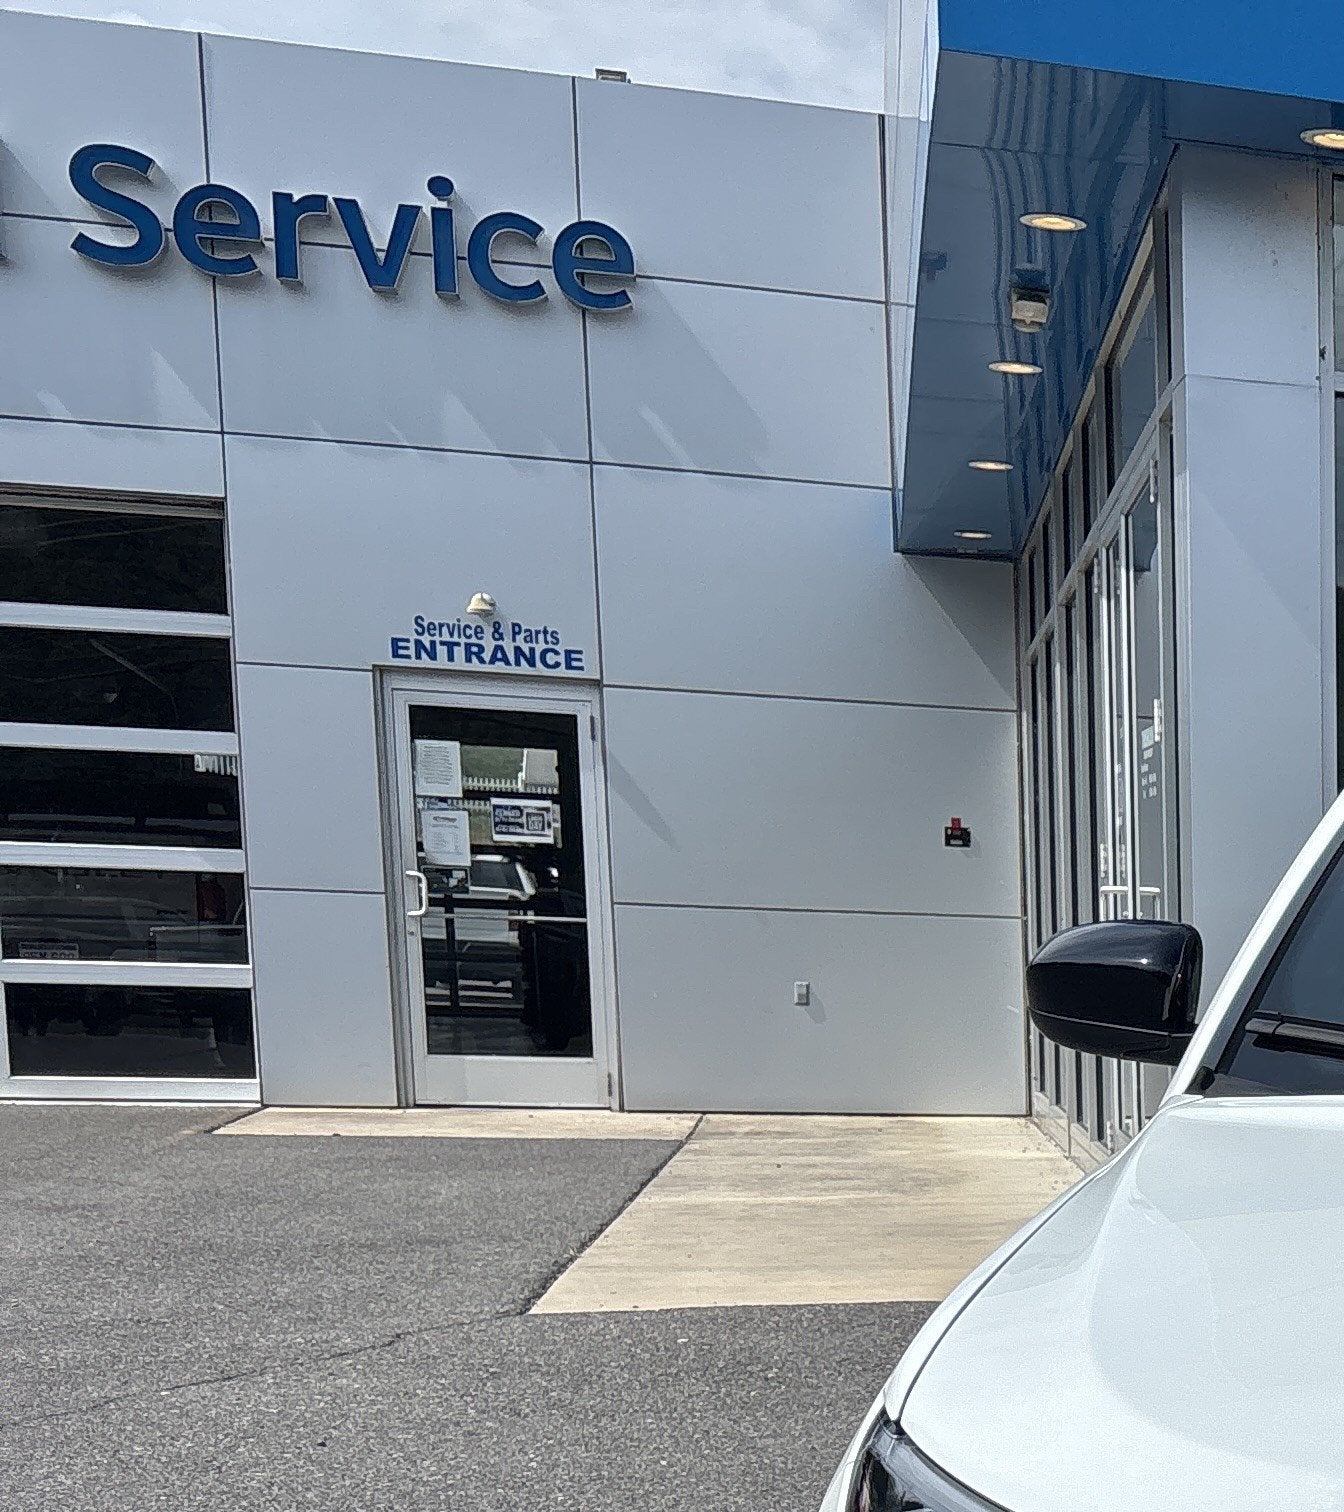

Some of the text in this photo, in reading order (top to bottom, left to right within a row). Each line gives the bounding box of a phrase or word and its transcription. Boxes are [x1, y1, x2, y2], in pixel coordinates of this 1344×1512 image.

[68, 143, 637, 313] Service
[413, 615, 560, 647] Service & Parts
[390, 637, 586, 672] ENTRANCE
